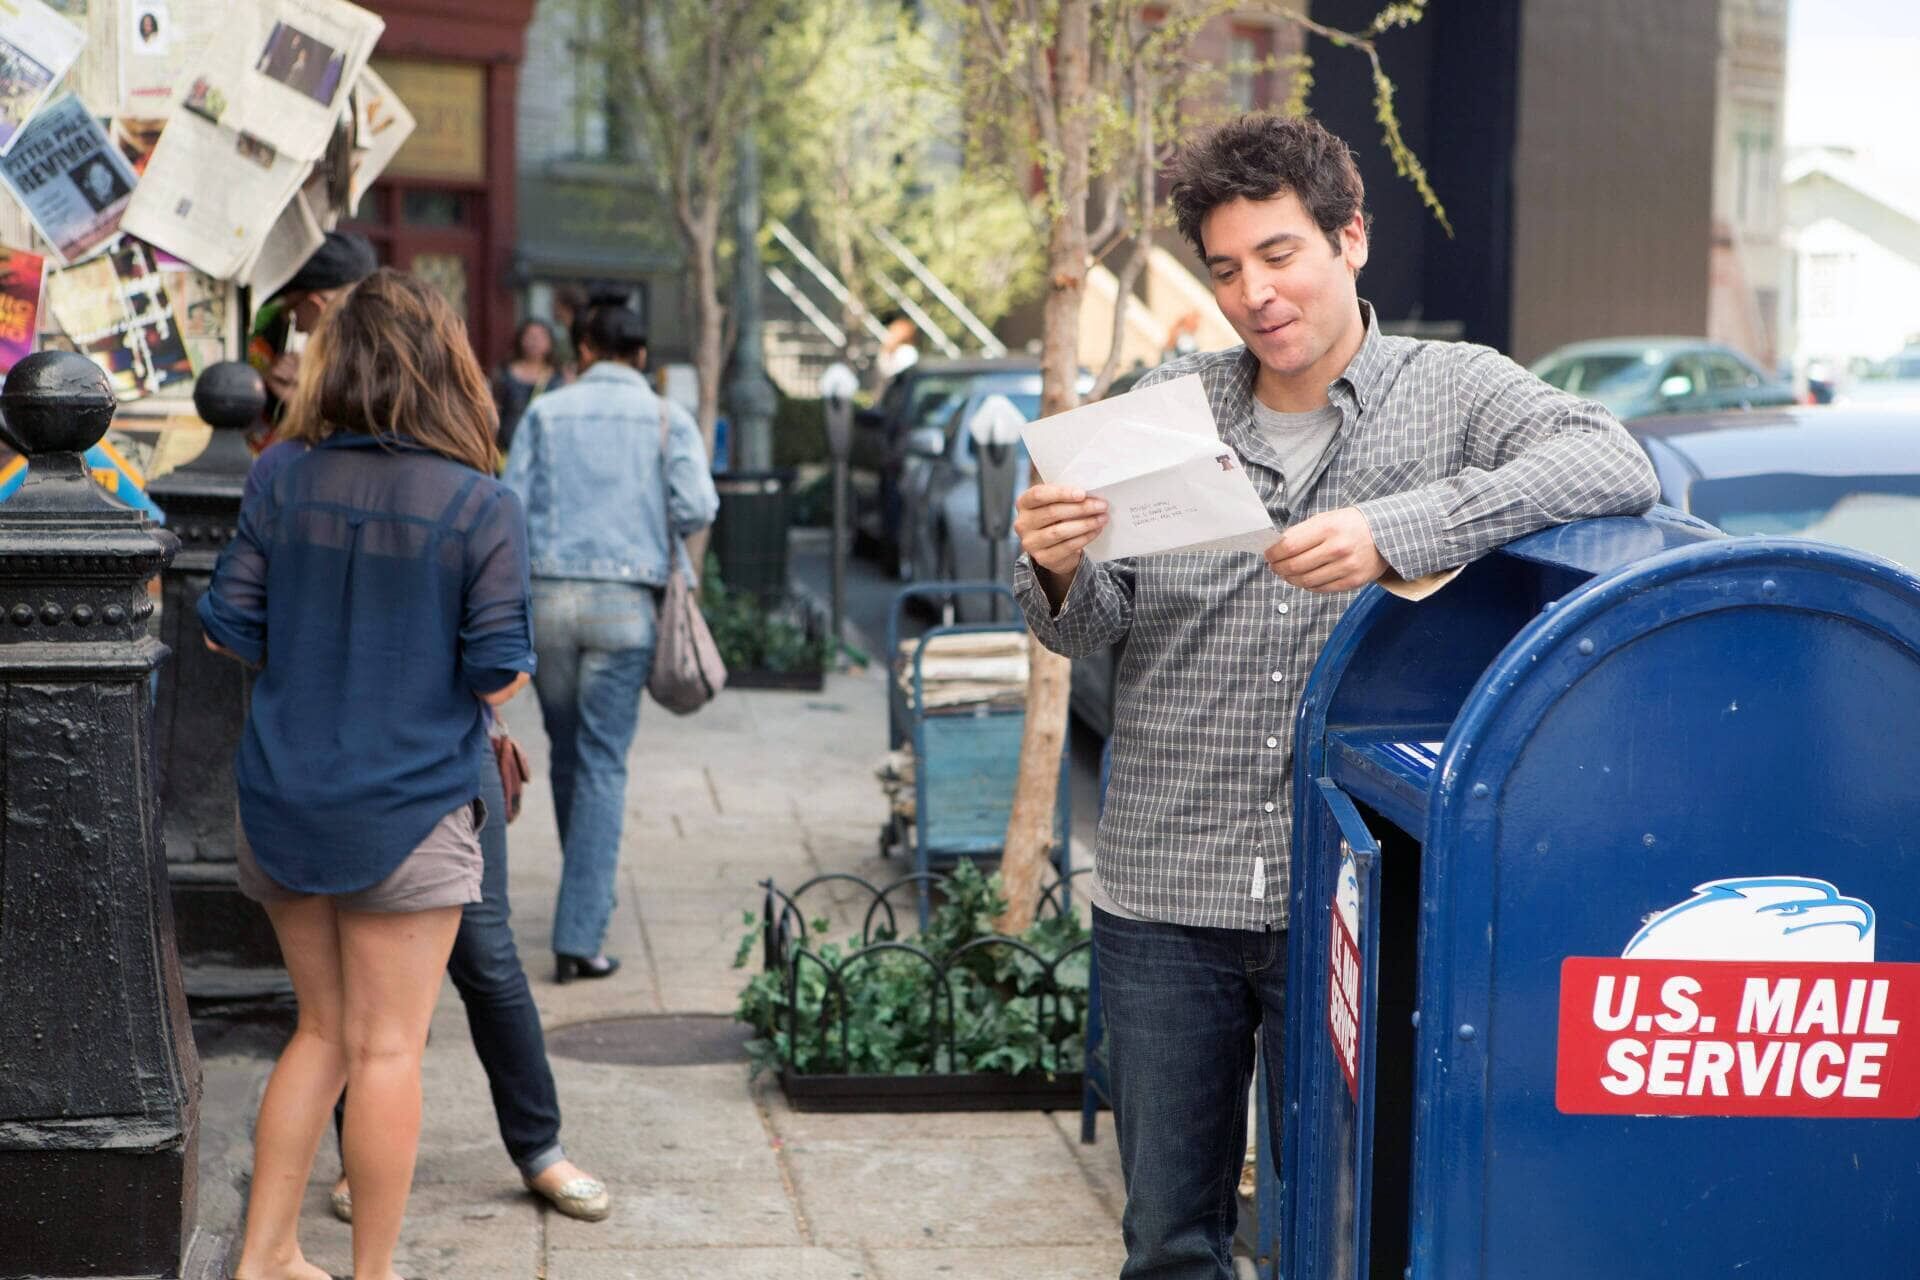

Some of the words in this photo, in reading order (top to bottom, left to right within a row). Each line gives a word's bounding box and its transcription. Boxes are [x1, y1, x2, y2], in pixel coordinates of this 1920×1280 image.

[1592, 975, 1717, 1033] U.S.
[1736, 977, 1901, 1035] MAIL
[1600, 1038, 1889, 1099] SERVICE
